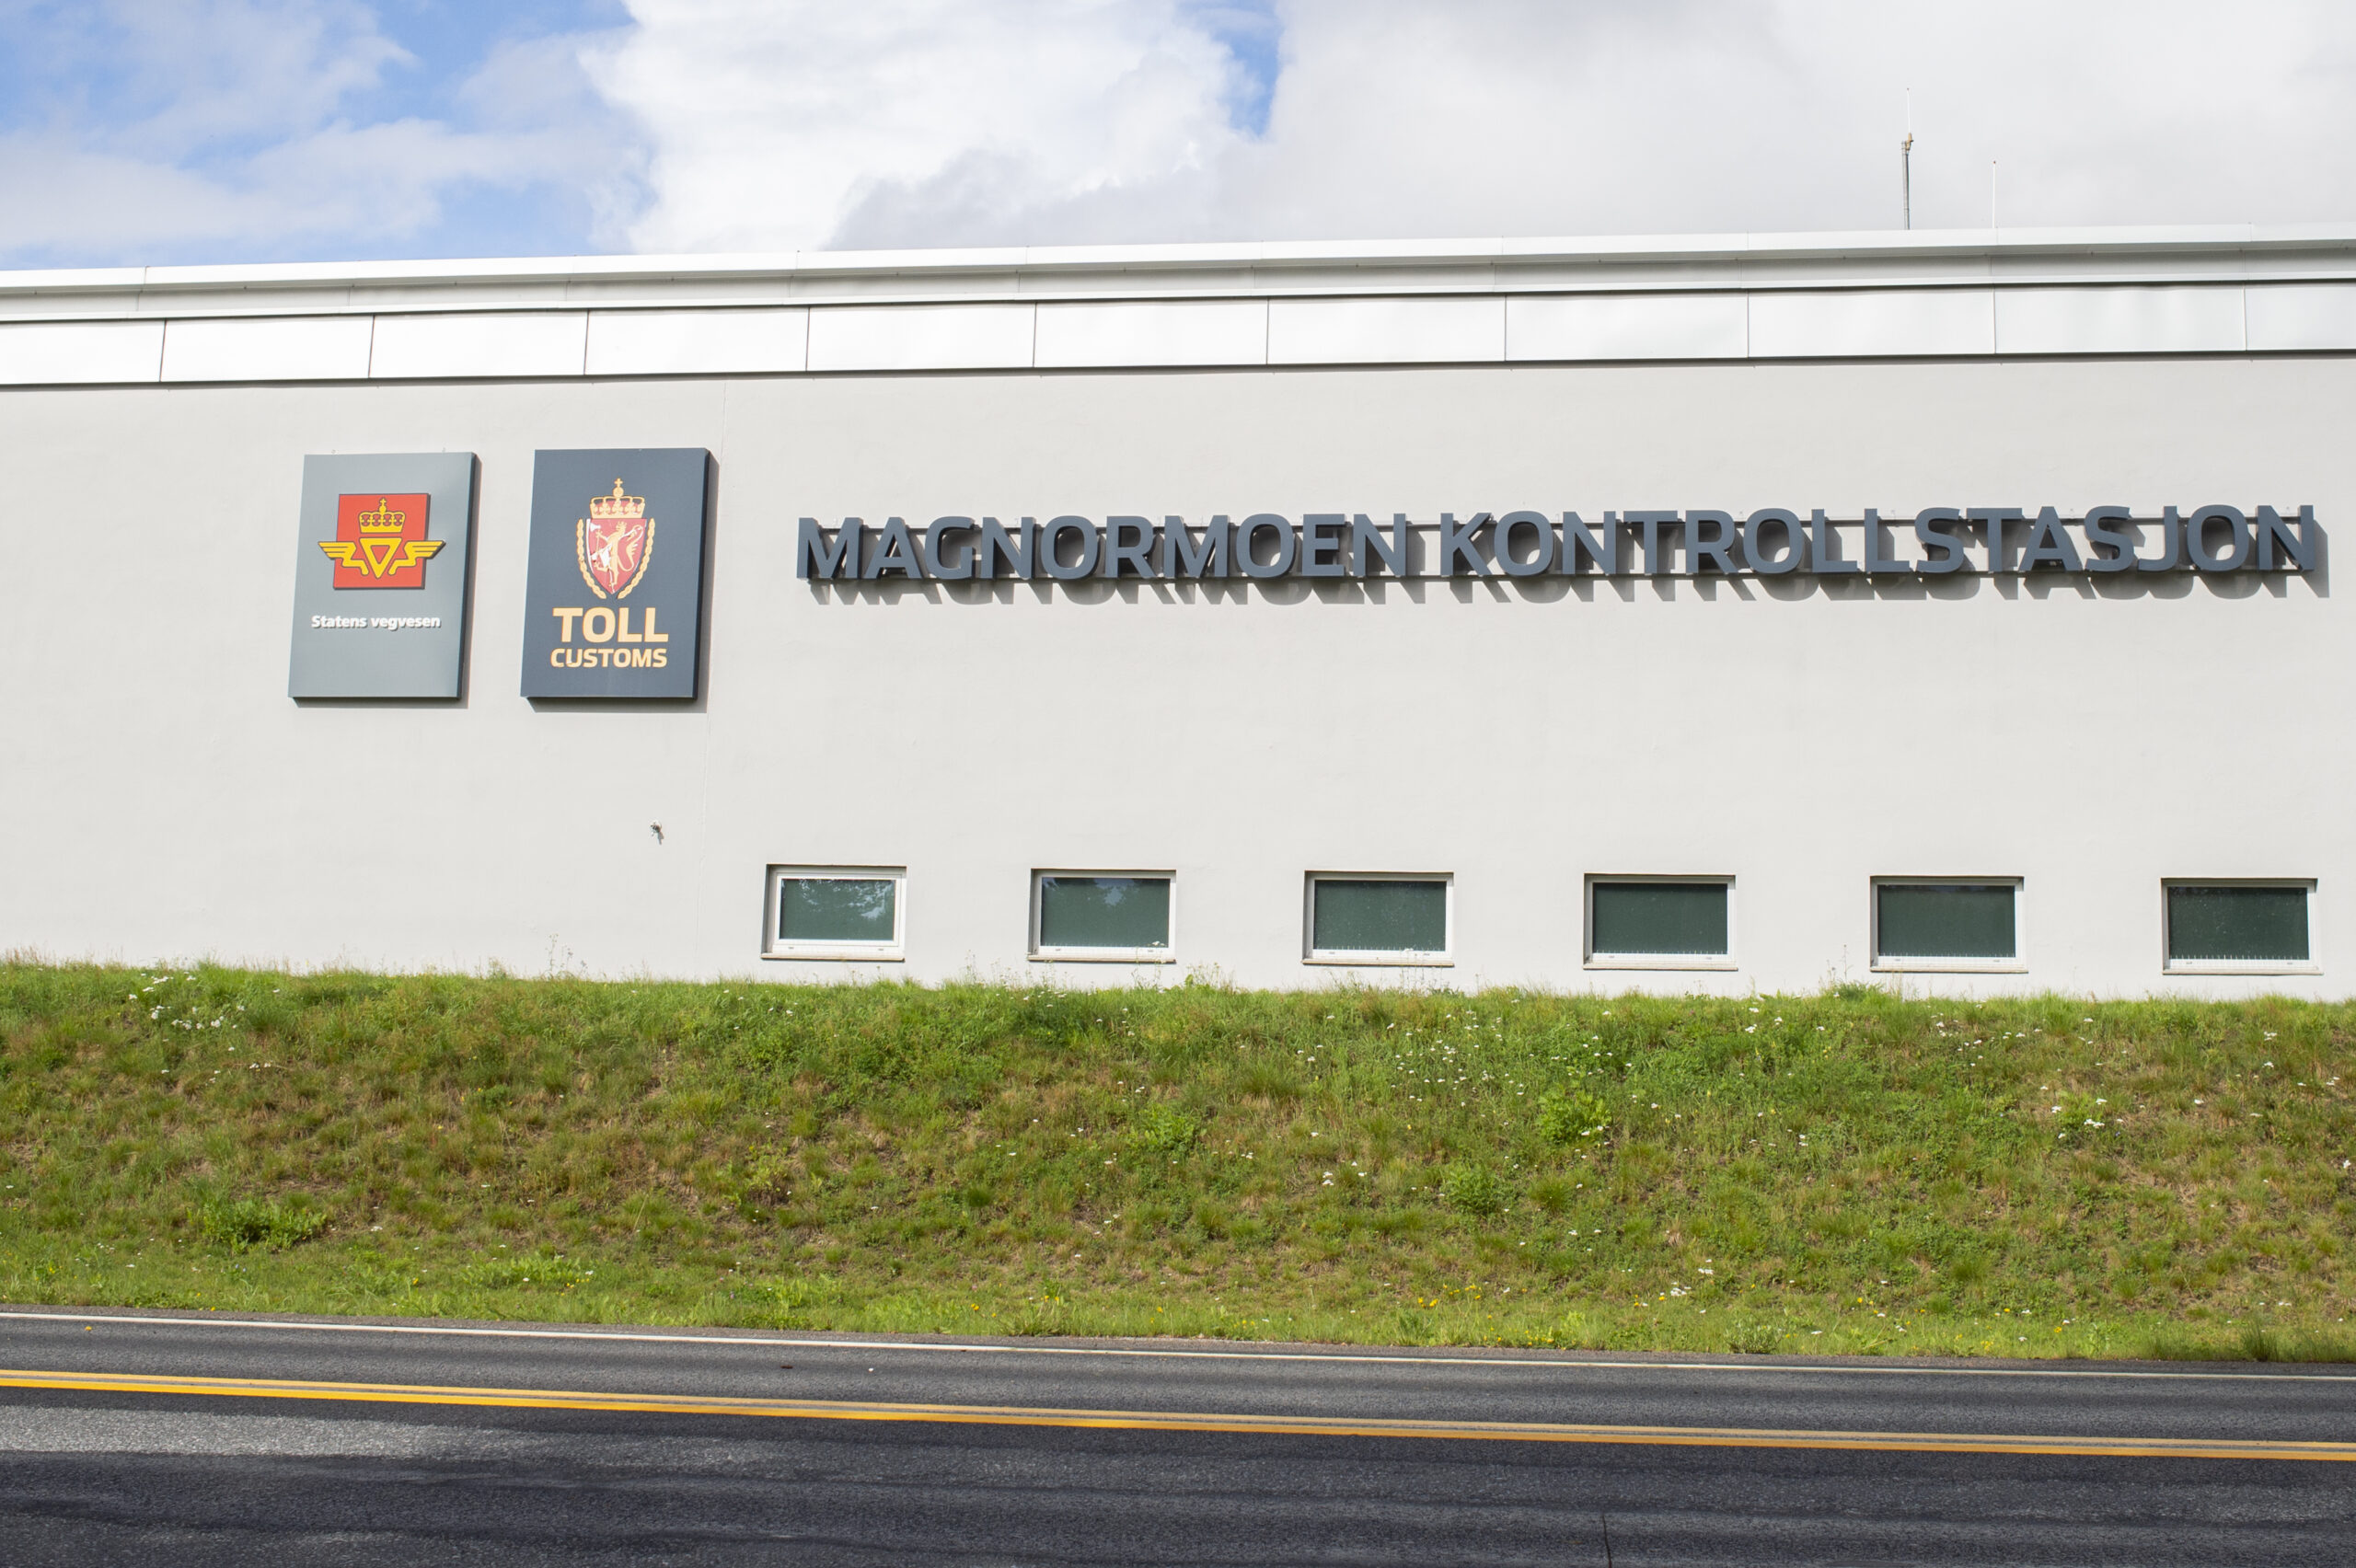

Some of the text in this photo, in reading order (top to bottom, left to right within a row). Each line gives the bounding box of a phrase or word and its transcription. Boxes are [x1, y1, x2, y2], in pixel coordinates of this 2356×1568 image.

[797, 505, 2315, 580] MAGNORMOEN KONTROLLSTASJON
[311, 615, 441, 630] Statens vegvesen
[552, 606, 669, 642] TOLL
[550, 647, 667, 668] CUSTOMS
